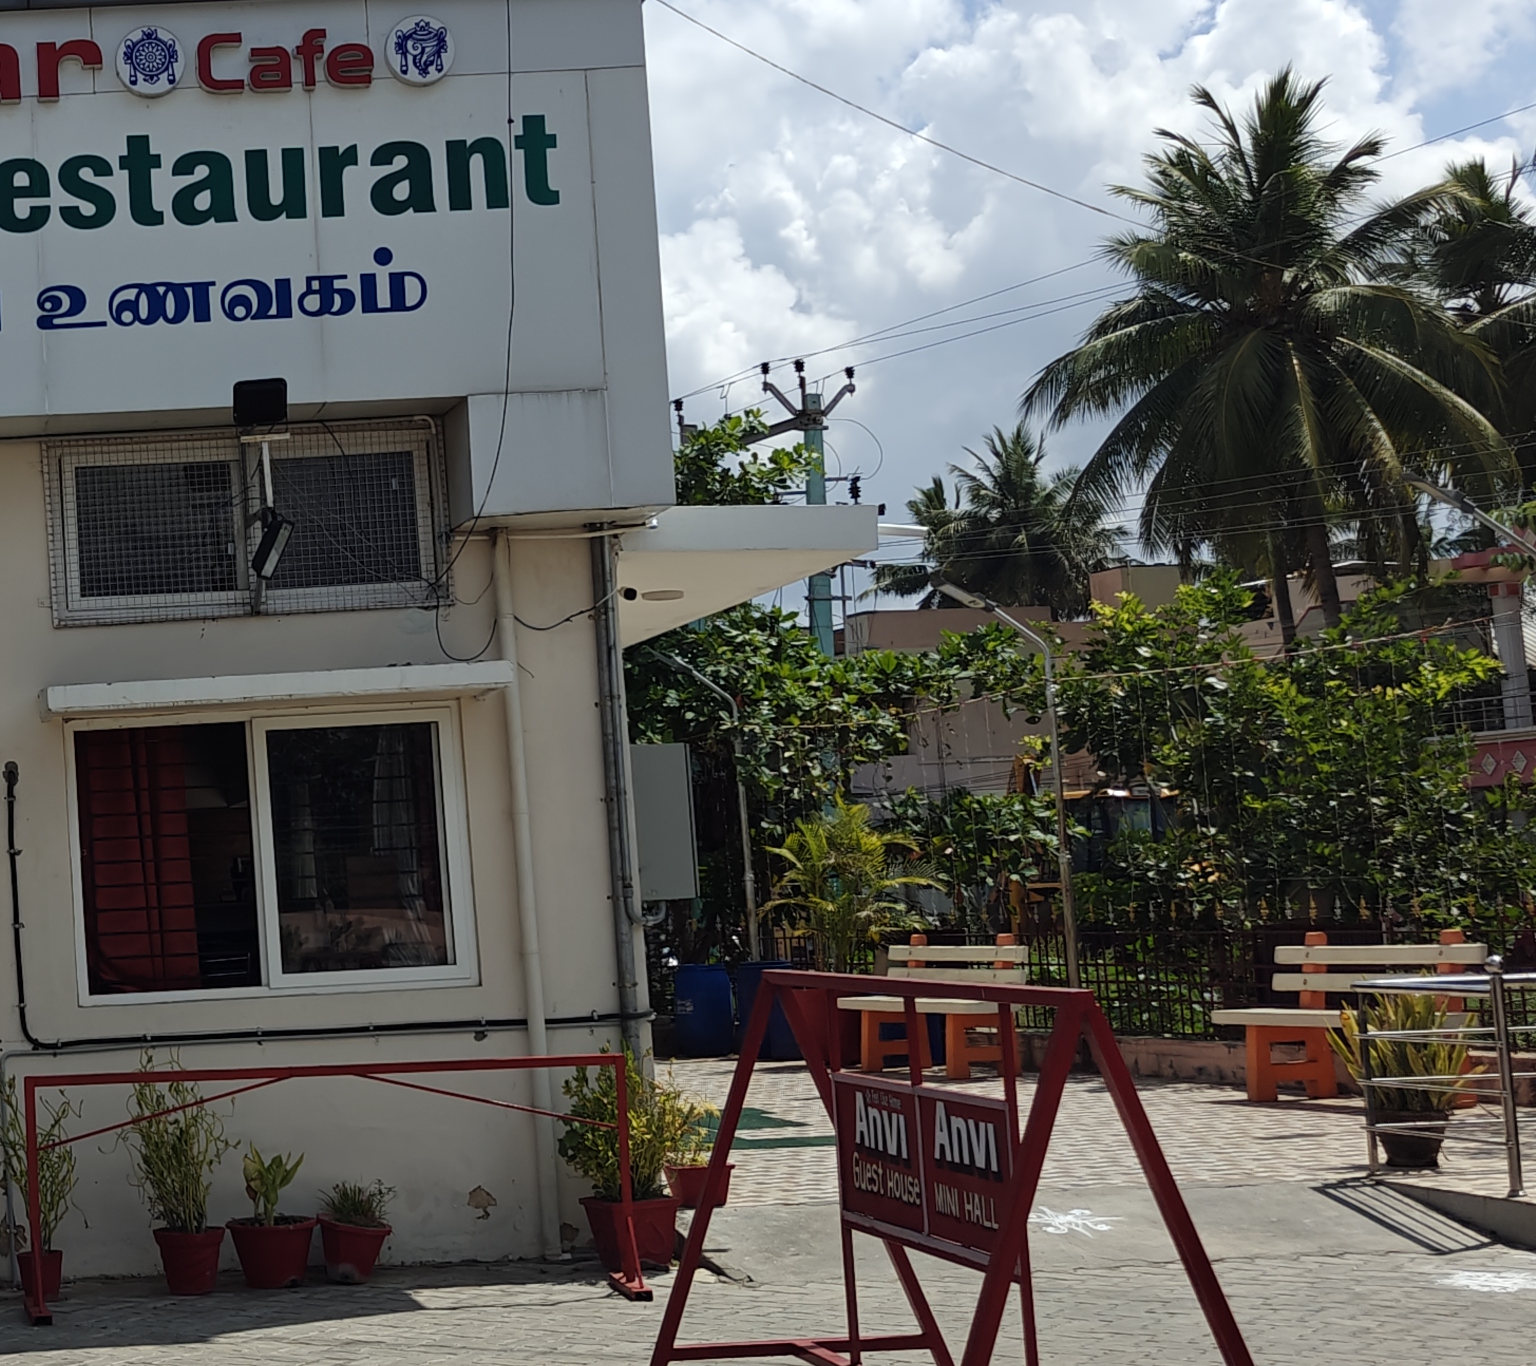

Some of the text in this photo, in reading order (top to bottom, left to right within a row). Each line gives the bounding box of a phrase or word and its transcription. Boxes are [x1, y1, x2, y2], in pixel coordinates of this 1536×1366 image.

[196, 29, 375, 92] Cafe
[35, 246, 428, 331] உணவகம்
[853, 1152, 885, 1195] Guest
[934, 1182, 999, 1229] MINI HALL
